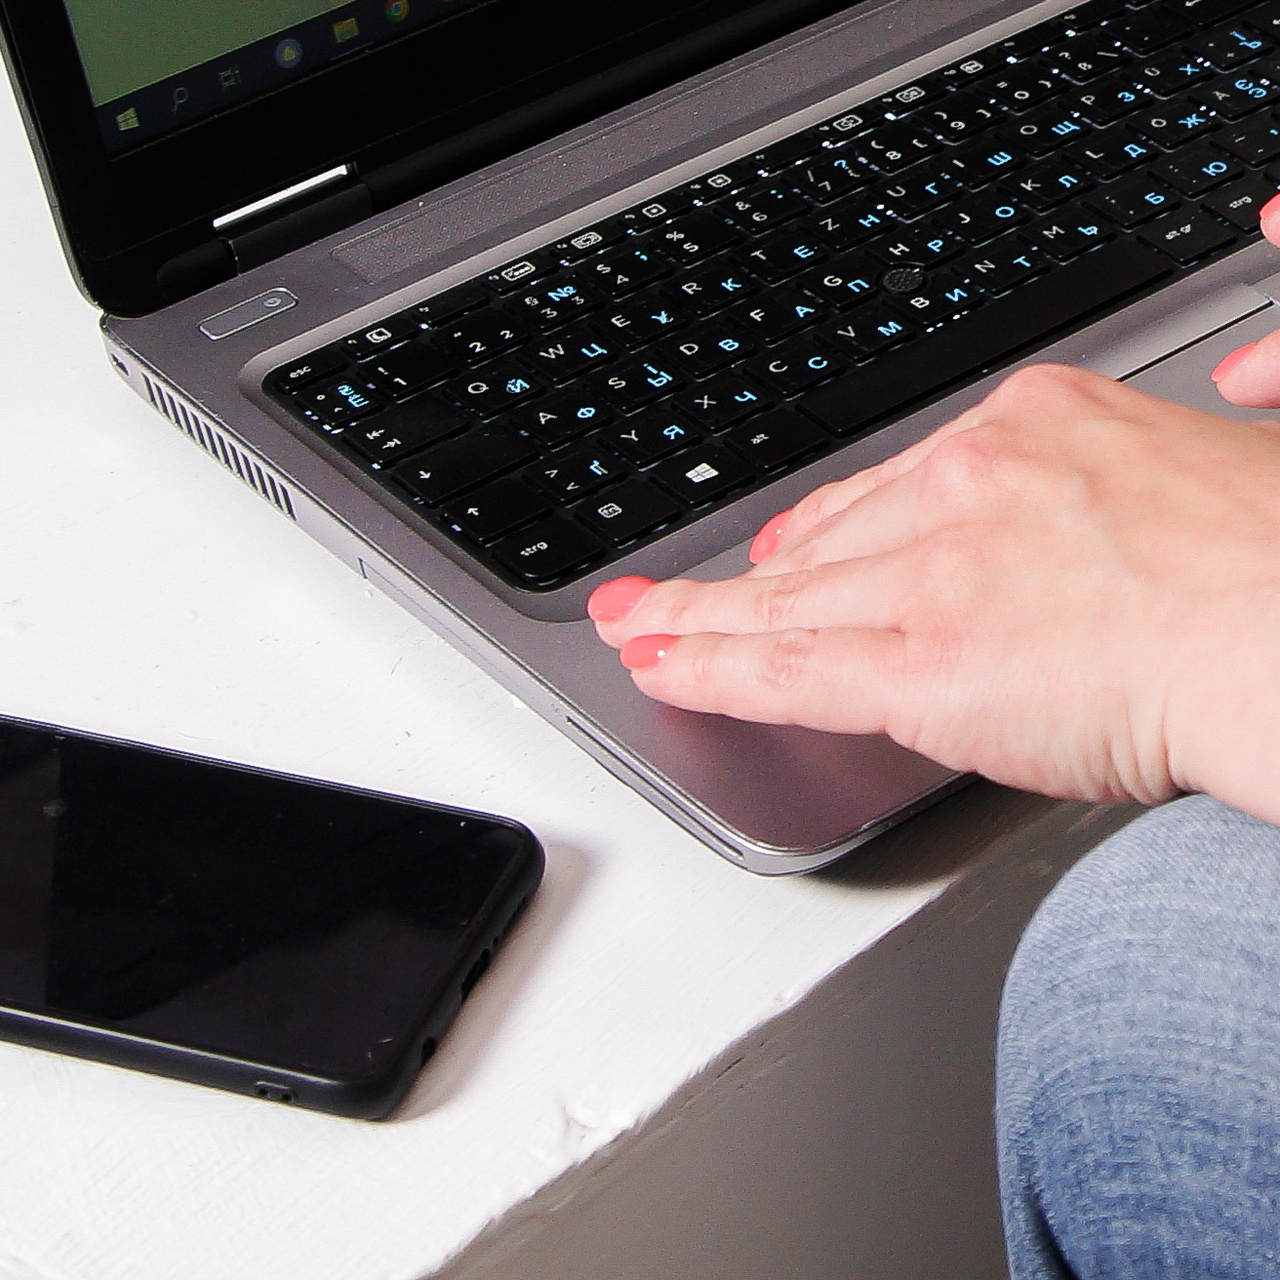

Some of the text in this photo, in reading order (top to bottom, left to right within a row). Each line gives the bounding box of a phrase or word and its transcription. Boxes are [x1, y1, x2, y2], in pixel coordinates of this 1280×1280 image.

[1080, 95, 1096, 106] P
[1178, 113, 1206, 129] Ж
[1085, 150, 1104, 159] L
[952, 159, 965, 168] I
[886, 185, 906, 197] U
[1019, 178, 1041, 191] K
[818, 217, 840, 231] Z
[958, 212, 971, 224] J
[1042, 225, 1065, 239] M
[750, 249, 767, 261] T
[888, 243, 910, 256] H
[974, 259, 996, 273] N
[823, 275, 843, 287] G
[681, 282, 703, 295] R
[910, 296, 930, 309] B
[610, 314, 631, 328] E
[749, 308, 765, 322] F
[836, 325, 856, 338] V
[538, 343, 565, 359] W
[679, 343, 699, 356] D
[289, 365, 312, 379] esc
[467, 382, 490, 394] Q
[608, 376, 626, 389] S
[694, 394, 717, 409] X
[538, 412, 558, 425] A
[620, 429, 639, 442] Y
